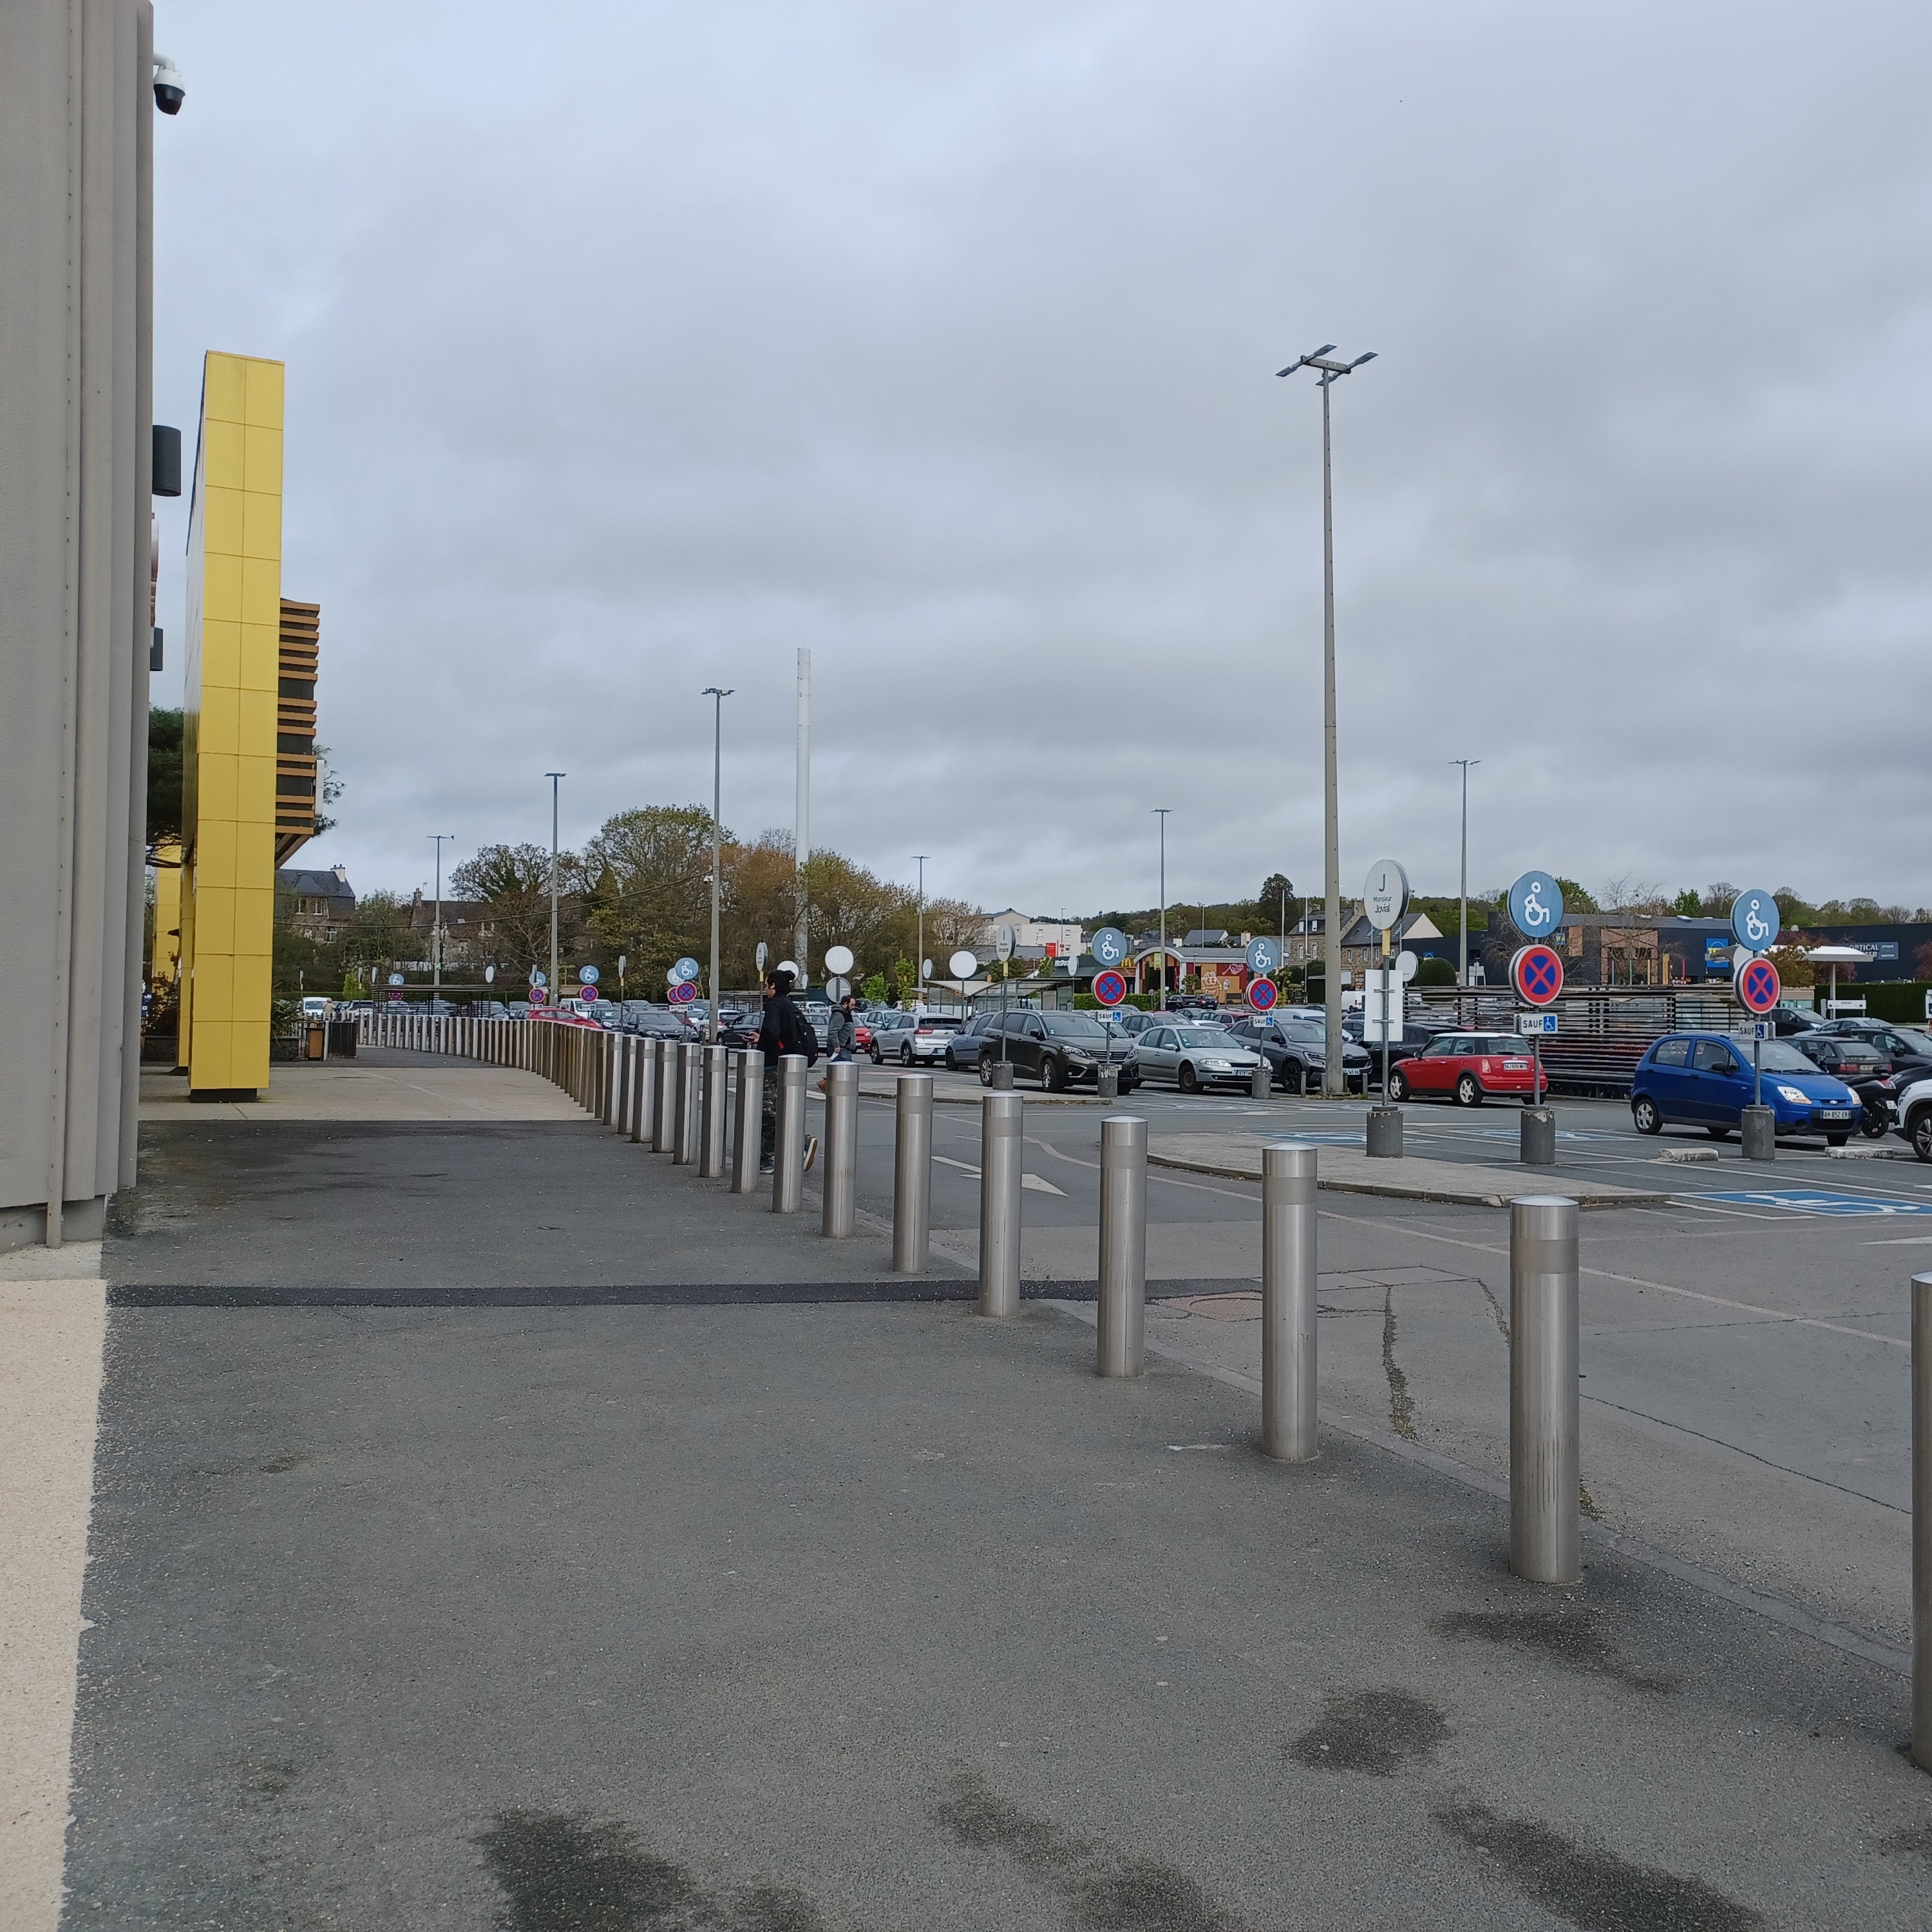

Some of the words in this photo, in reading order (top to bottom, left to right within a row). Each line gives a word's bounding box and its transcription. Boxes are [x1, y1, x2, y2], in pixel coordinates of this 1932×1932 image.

[1379, 873, 1385, 892] J
[1375, 903, 1390, 913] Jovial
[1523, 1019, 1543, 1028] SAUF
